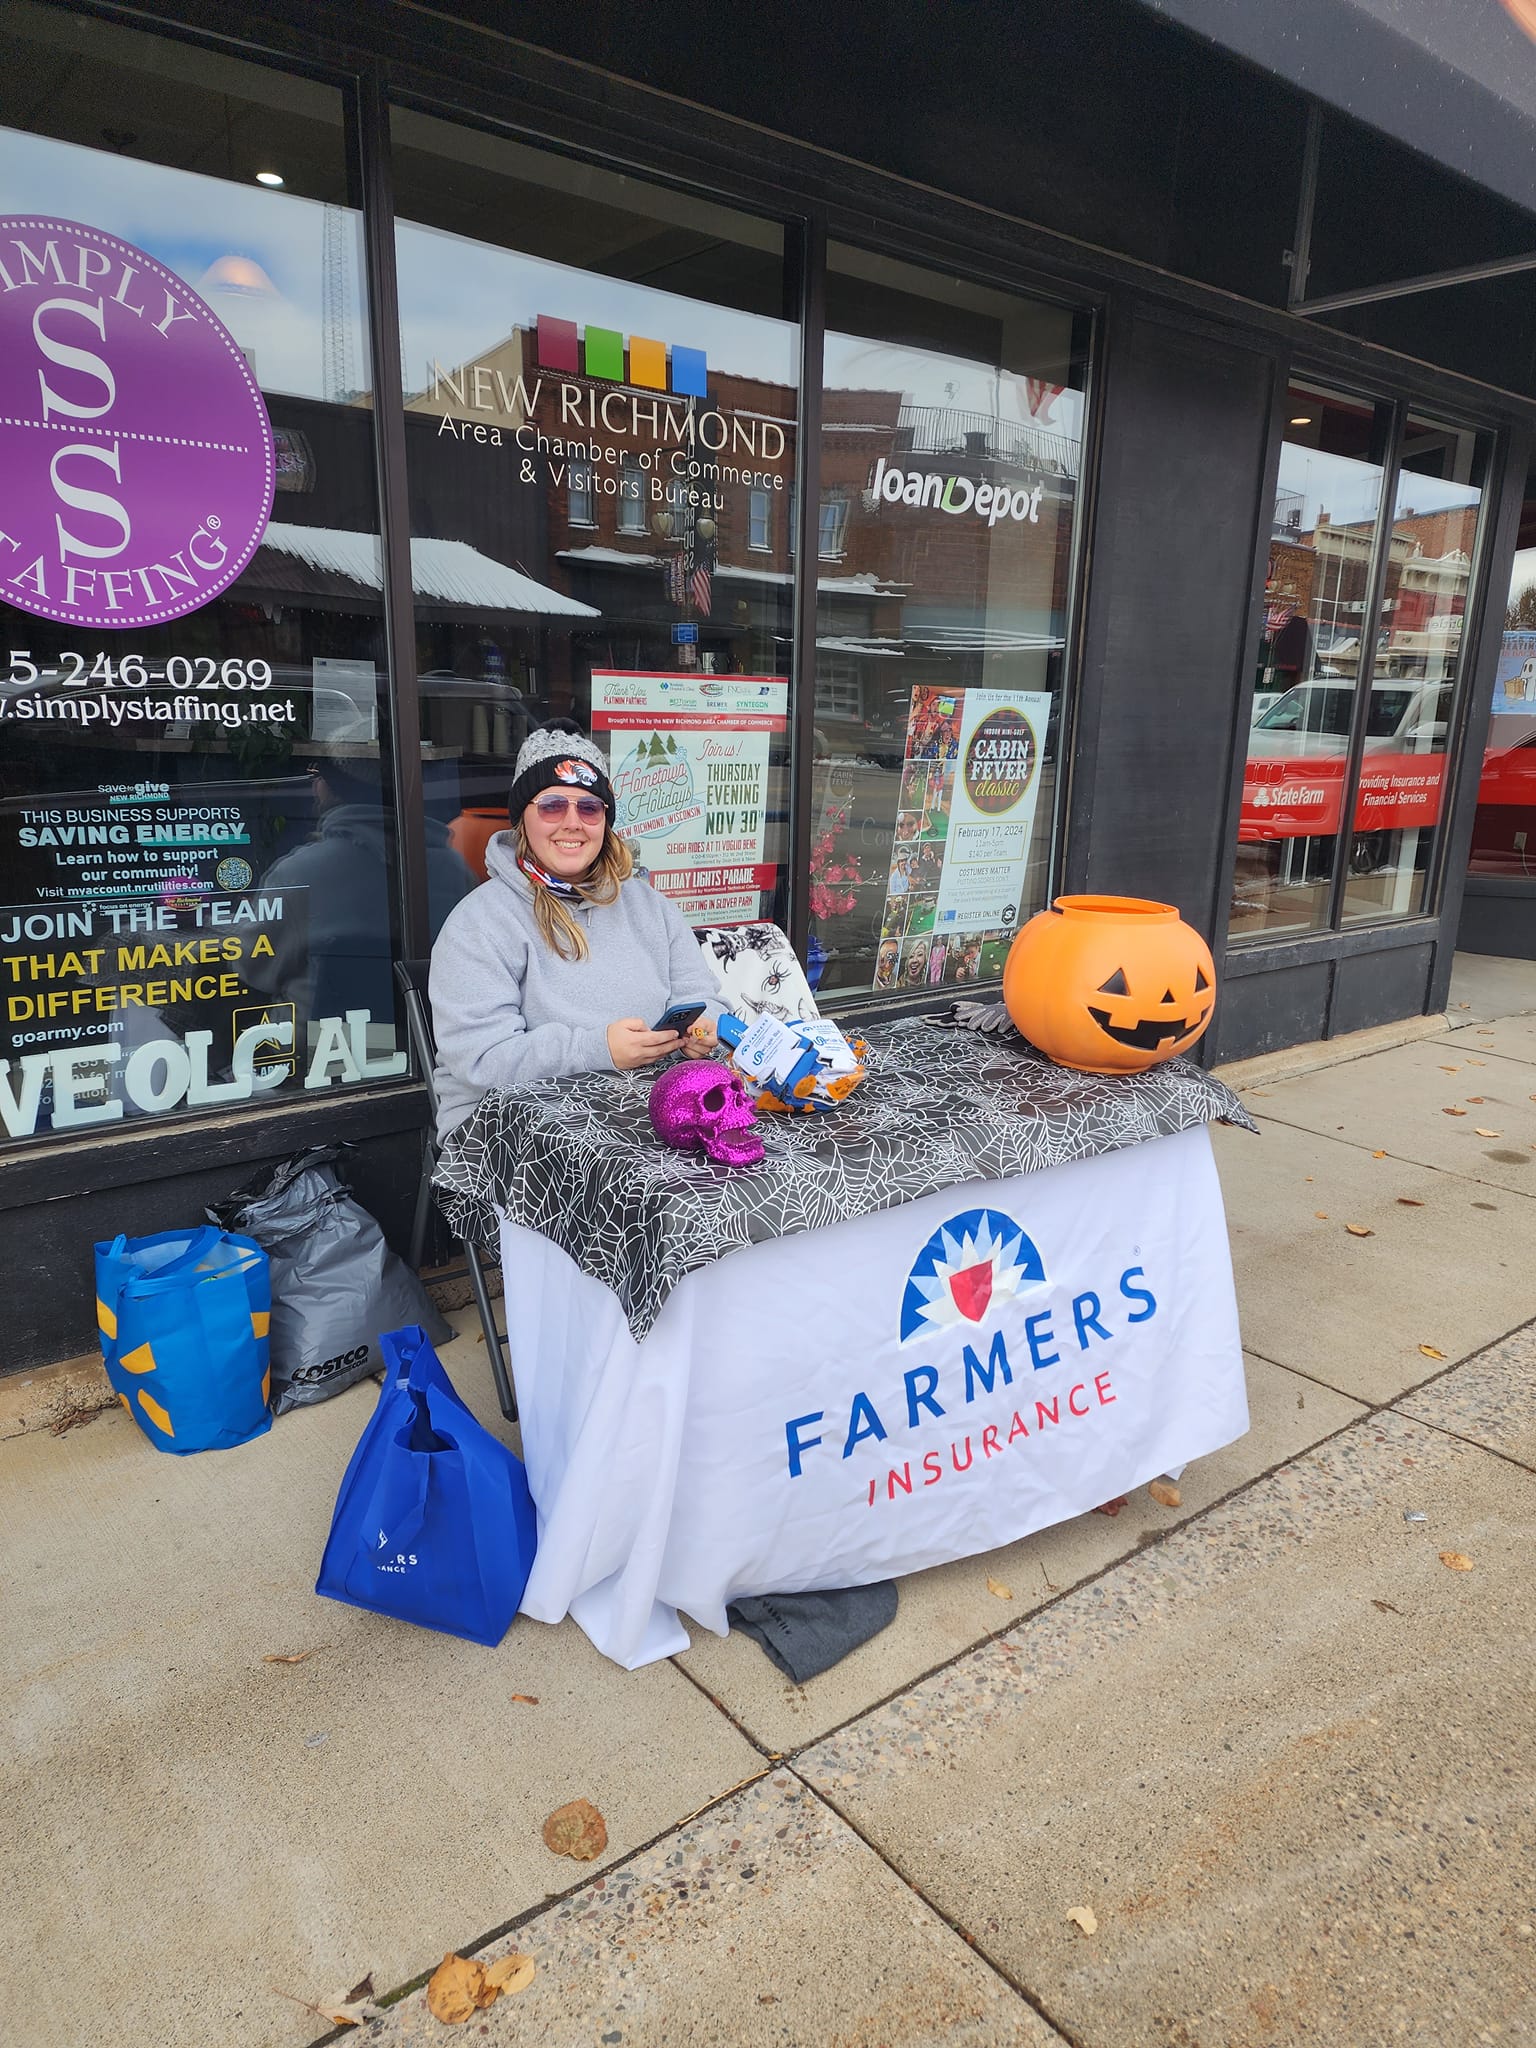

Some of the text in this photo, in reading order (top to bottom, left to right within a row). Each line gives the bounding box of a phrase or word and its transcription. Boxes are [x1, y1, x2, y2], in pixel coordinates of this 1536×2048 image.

[32, 295, 117, 422] S
[434, 358, 786, 460] NEW RICHMOND
[438, 412, 784, 490] Area Chamber of Commerce
[519, 458, 724, 510] & Visitors Bureau
[872, 457, 1042, 527] loanDepot
[50, 440, 132, 563] S
[0, 650, 272, 691] 5-246-0269
[696, 739, 724, 760] Join
[974, 739, 1029, 759] CABIN
[612, 763, 687, 800] Hometown
[707, 763, 761, 782] THURSDAY
[970, 760, 1028, 780] FEVER
[1390, 774, 1426, 788] Insurance
[1427, 773, 1440, 786] and
[97, 783, 126, 793] save
[134, 781, 170, 795] give
[707, 784, 759, 806] EVENING
[975, 773, 1020, 796] classic
[110, 792, 169, 802] NEW RICHMOND
[628, 787, 691, 821] Holidays
[1363, 791, 1428, 806] Financial Services
[20, 807, 241, 824] THIS BUSINESS SUPPORTS
[617, 827, 632, 839] NEW
[668, 806, 701, 824] WISCONSIN
[706, 811, 735, 835] NOV
[18, 822, 246, 847] SAVING ENERGY
[958, 828, 990, 839] February
[1005, 826, 1023, 836] 2024
[56, 848, 219, 866] Learn how to support
[667, 842, 686, 854] SLEIGH
[688, 841, 704, 853] RIDES
[706, 841, 714, 852] AT
[743, 839, 756, 850] BENE
[81, 864, 199, 883] our community!
[654, 868, 754, 890] HOLIDAY LIGHTS PARADE
[959, 866, 1011, 877] COSTUMES MATTER
[36, 880, 214, 899] Visit myaccount.nrutilities.com
[682, 901, 707, 912] LIGHTING
[709, 900, 715, 909] IN
[739, 896, 753, 907] PARK
[958, 910, 1000, 919] REGISTER ONLINE
[1, 897, 283, 943] JOIN THE TEAM
[3, 934, 275, 982] THAT MAKES A
[8, 973, 248, 1022] DIFFERENCE.
[11, 1020, 124, 1047] goarmy.com
[291, 1345, 369, 1383] COSTCO
[785, 1267, 1158, 1479] FARMERS
[868, 1371, 1118, 1507] INSURANCE
